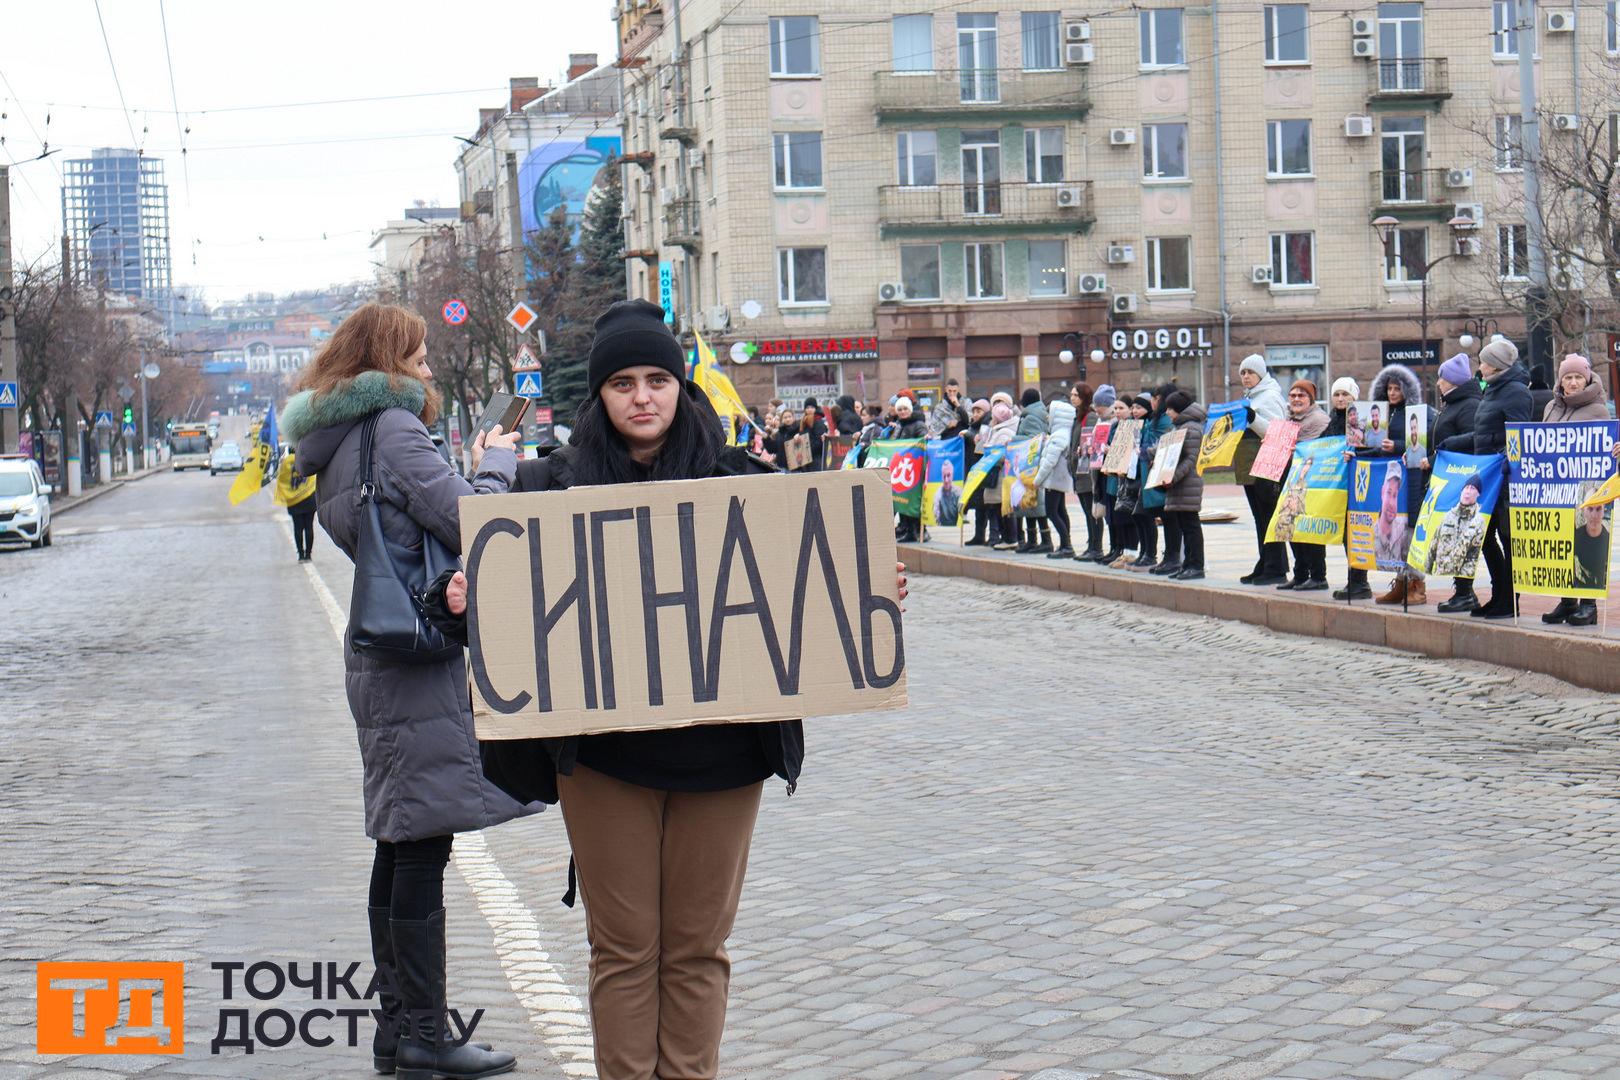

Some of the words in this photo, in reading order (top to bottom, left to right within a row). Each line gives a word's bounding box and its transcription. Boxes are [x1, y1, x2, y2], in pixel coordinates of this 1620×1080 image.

[761, 338, 839, 354] АПТЕКА
[1112, 328, 1212, 351] GOGOL
[1112, 351, 1162, 359] COFFEE
[1171, 349, 1212, 358] SPACE
[1523, 426, 1614, 453] ПОВЕРНІТЬ
[1521, 457, 1554, 479] 56-та
[1557, 456, 1612, 479] ОМПБР
[1524, 511, 1551, 531] БОЯХ
[1529, 538, 1572, 560] ВАГНЕР
[1532, 567, 1574, 589] БЕРХІВКА
[467, 485, 905, 714] СИГНАЛЬ
